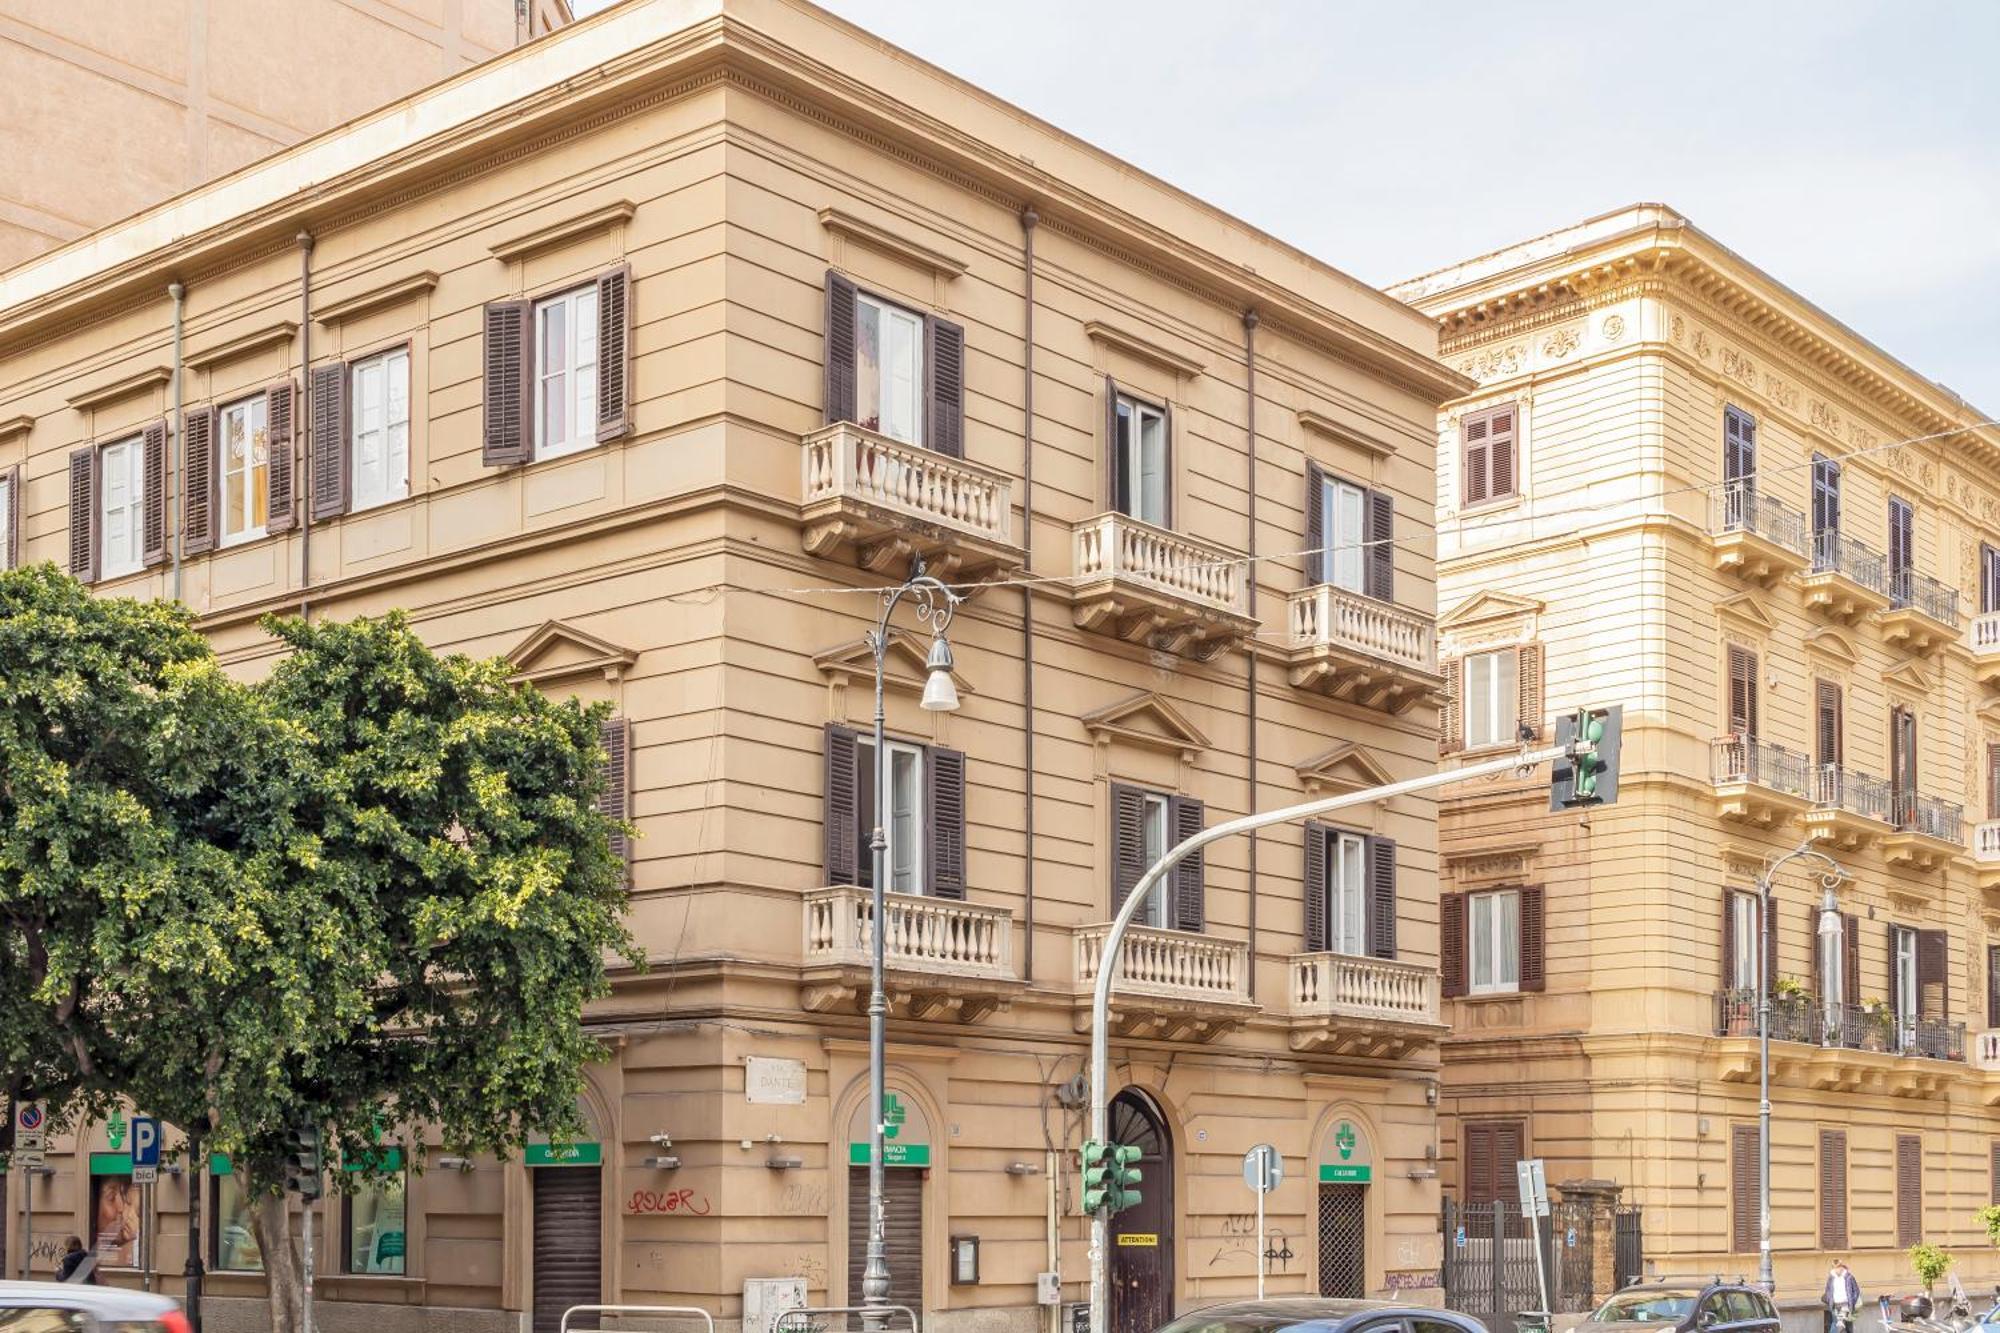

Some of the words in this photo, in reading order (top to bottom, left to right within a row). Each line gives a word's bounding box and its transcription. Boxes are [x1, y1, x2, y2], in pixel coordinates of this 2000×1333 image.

[760, 1076, 794, 1089] DANTE
[136, 1122, 155, 1162] P
[135, 1168, 155, 1180] bici
